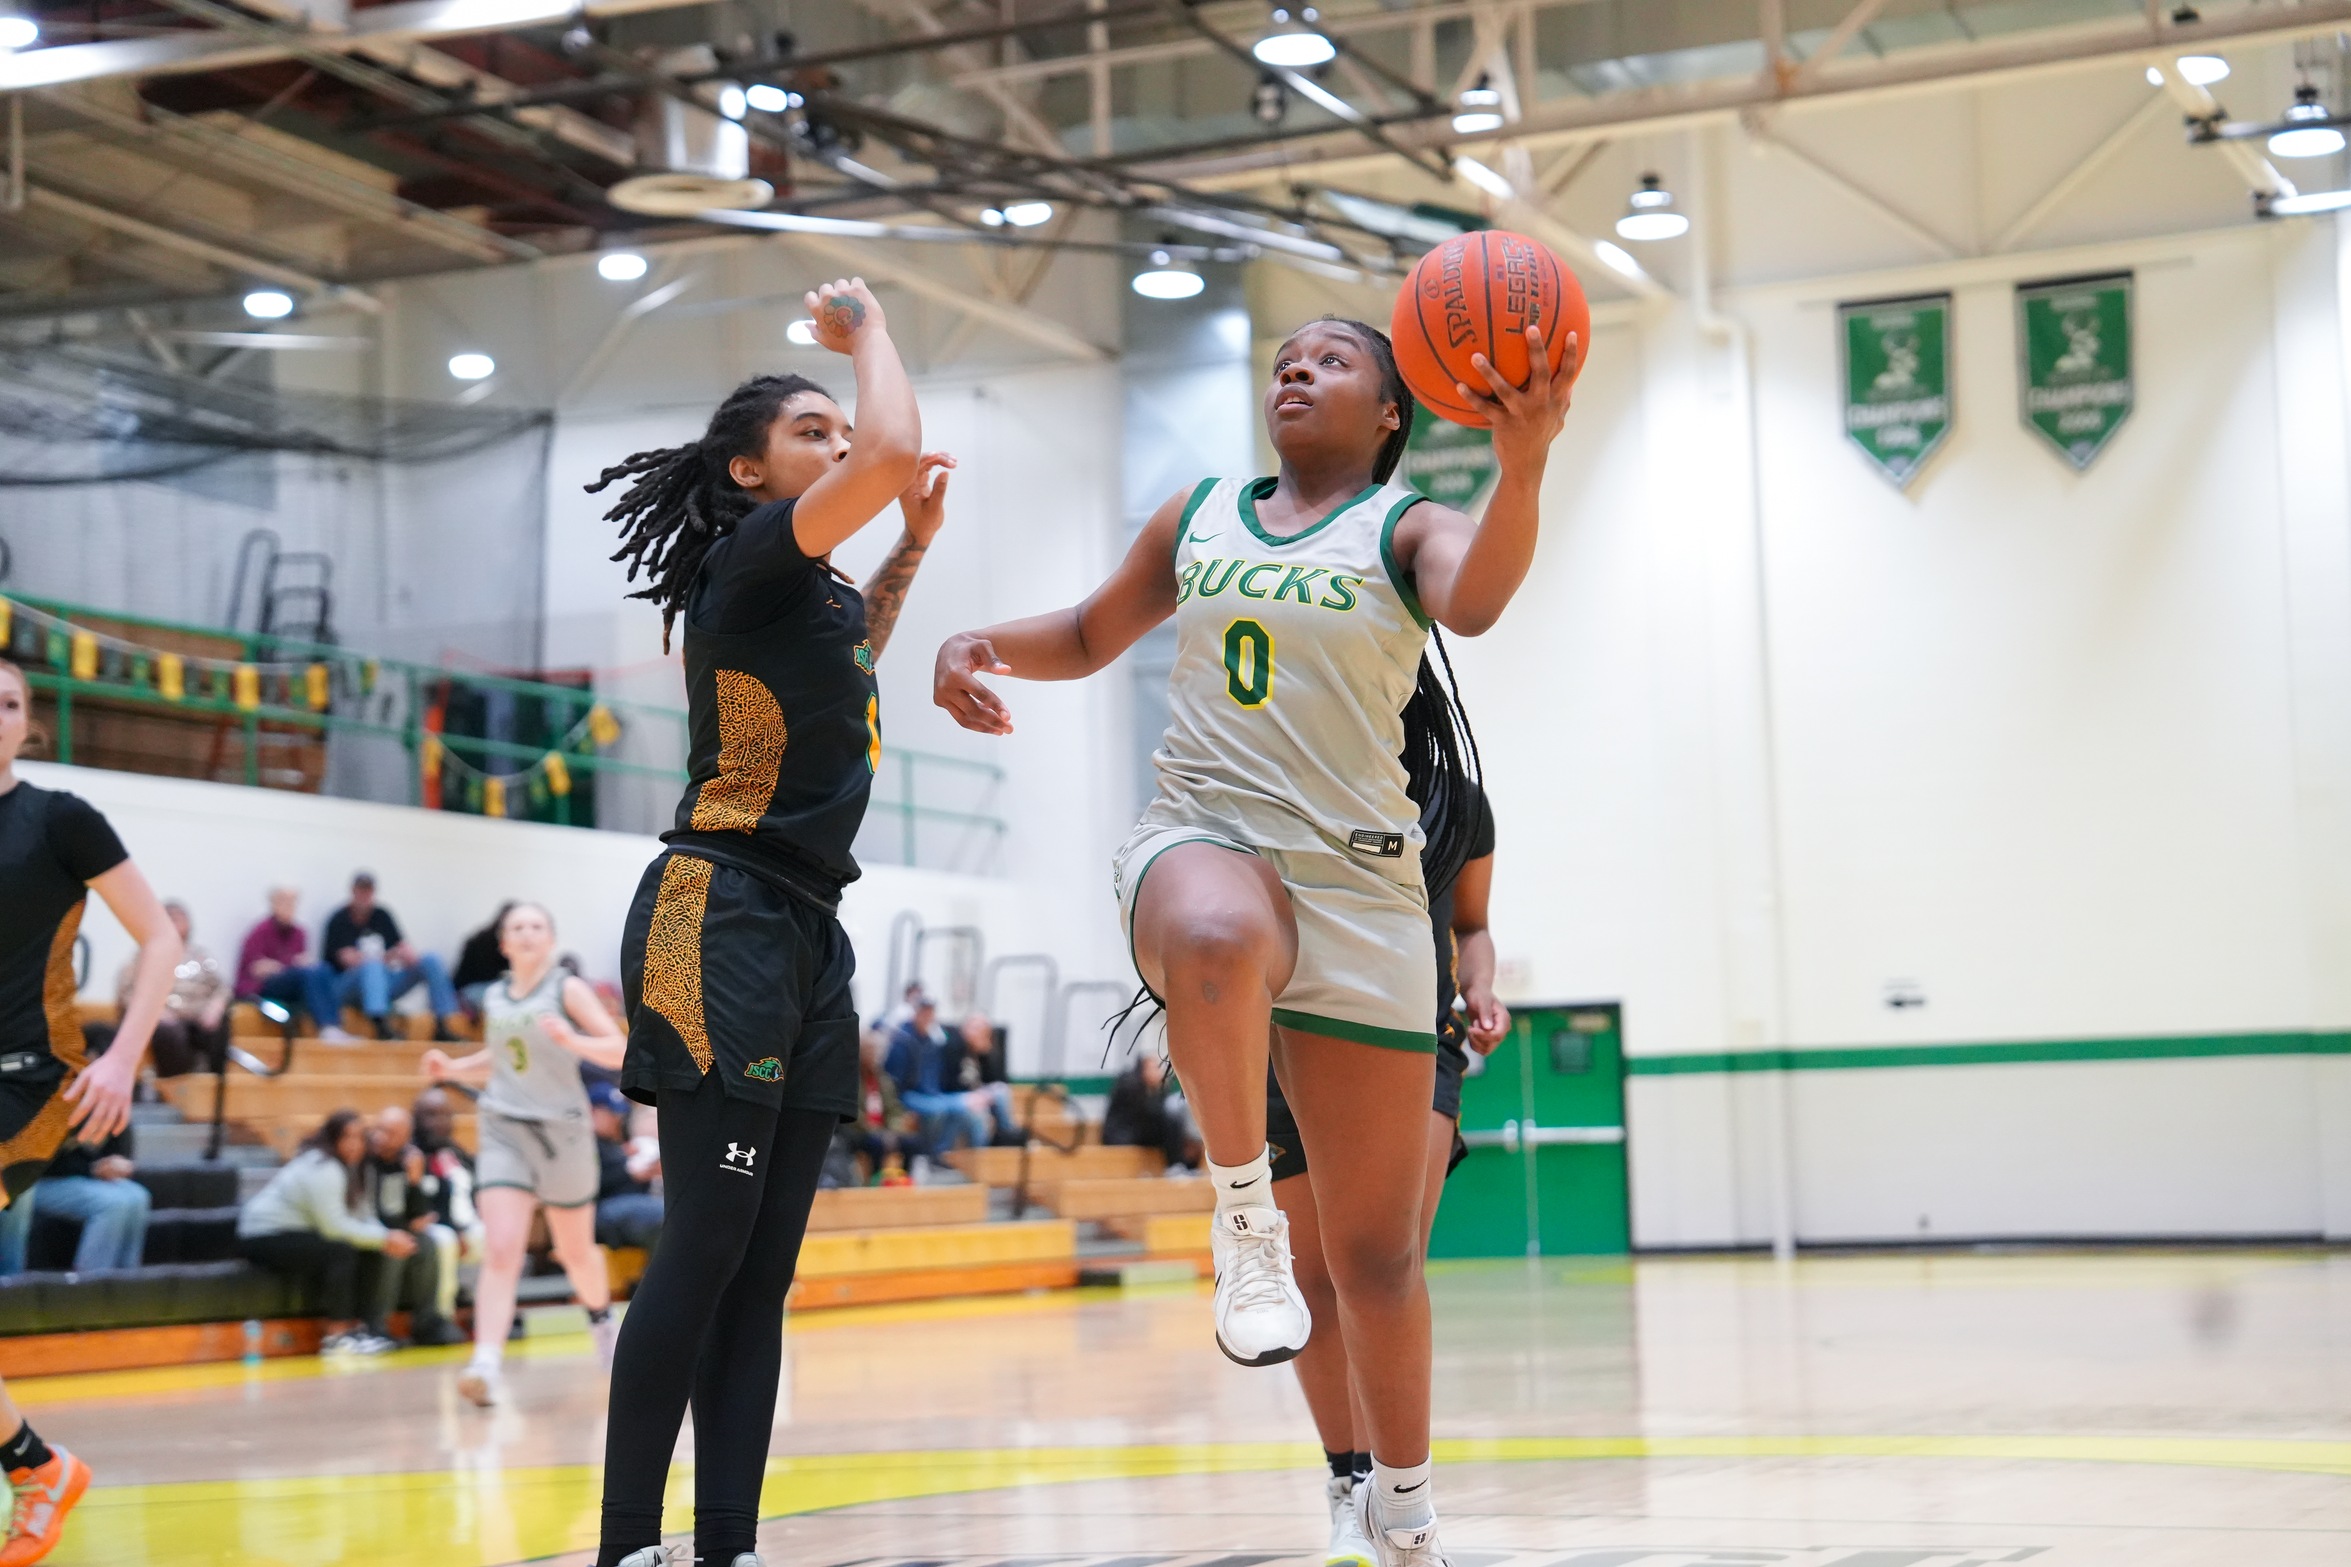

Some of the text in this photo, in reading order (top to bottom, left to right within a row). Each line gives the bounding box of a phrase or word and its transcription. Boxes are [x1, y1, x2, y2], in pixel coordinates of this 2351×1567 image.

[1442, 236, 1478, 349] SPALDIN
[1176, 558, 1366, 612] BUCKS
[1222, 617, 1275, 711] 0
[1388, 841, 1398, 851] M
[736, 1168, 754, 1177] ARMOUR
